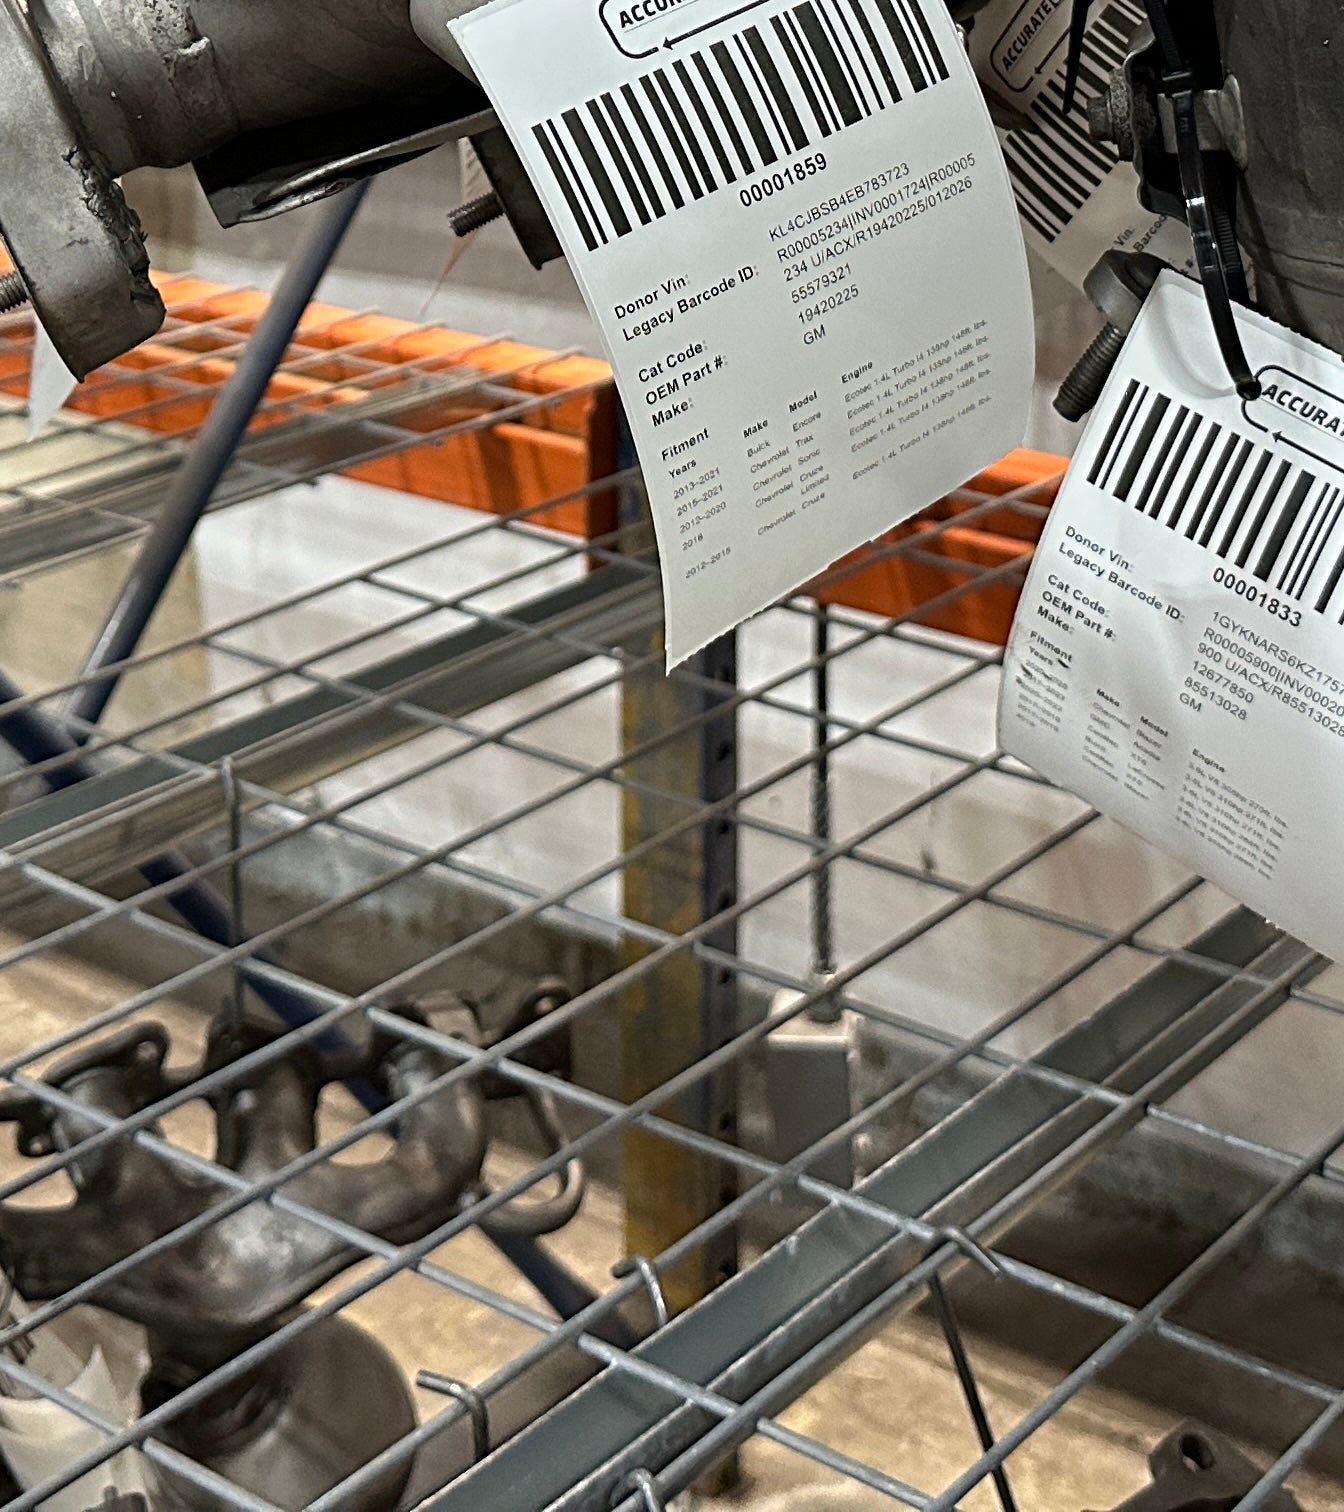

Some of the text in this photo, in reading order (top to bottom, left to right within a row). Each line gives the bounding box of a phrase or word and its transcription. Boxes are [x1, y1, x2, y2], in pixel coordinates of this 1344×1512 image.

[740, 154, 827, 208] 00001859
[768, 161, 910, 242] KL4CJBSB4EB783723
[782, 175, 973, 282] 234 U/ACX/R19420225/012026
[612, 270, 691, 319] Donor Vin:
[621, 262, 759, 342] Legacy Barcode ID:
[790, 262, 852, 304] 55579321
[797, 284, 860, 324] 19420225
[801, 323, 826, 346] GM
[636, 337, 708, 383] Cat Code:
[643, 377, 680, 405] OEM
[680, 361, 712, 387] Part
[650, 395, 694, 427] Make:
[668, 360, 874, 478] Years Make Model Engine
[659, 426, 710, 461] Fitment
[1064, 524, 1106, 556] Donor
[1046, 573, 1071, 593] Cat
[1056, 542, 1107, 578] Legacy
[1107, 571, 1164, 610] Barcode
[1213, 567, 1302, 628] 00001833
[1035, 605, 1076, 634] Make:
[1040, 590, 1073, 615] OEM
[1074, 609, 1103, 633] Part
[1029, 630, 1074, 662] Fitment
[1195, 641, 1223, 664] 900
[1177, 691, 1203, 712] GM
[1183, 676, 1248, 721] 85513028
[1190, 660, 1255, 704] 12677850
